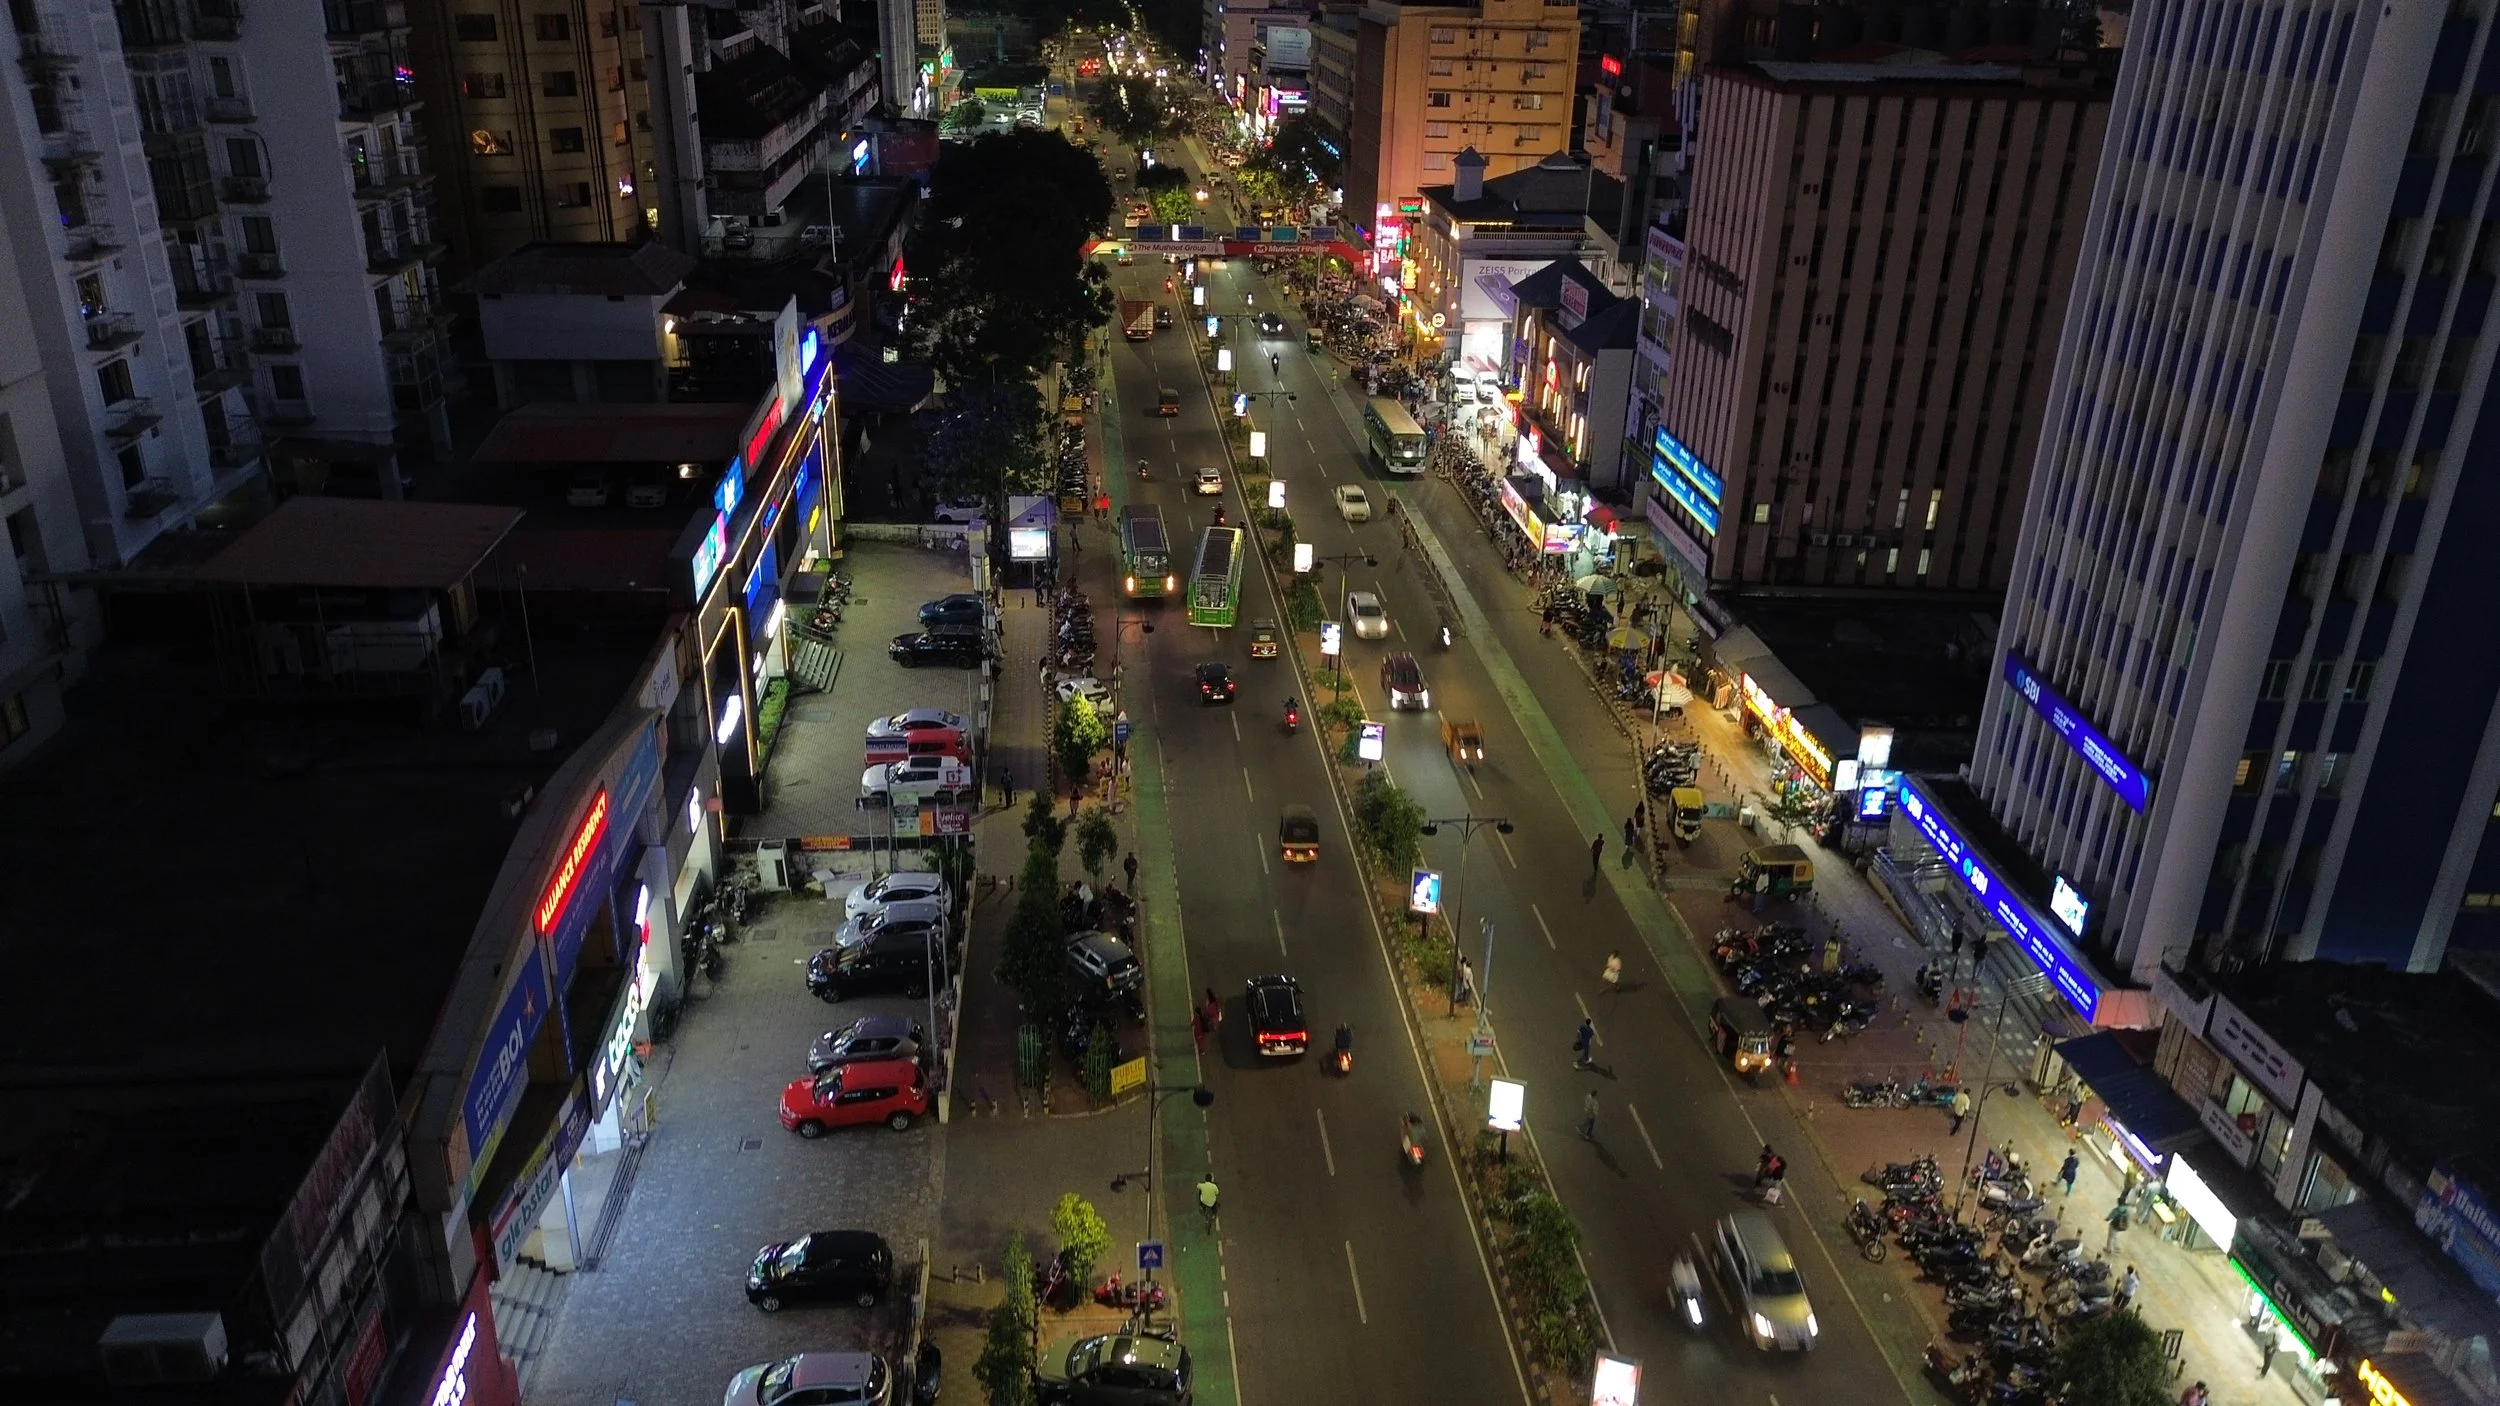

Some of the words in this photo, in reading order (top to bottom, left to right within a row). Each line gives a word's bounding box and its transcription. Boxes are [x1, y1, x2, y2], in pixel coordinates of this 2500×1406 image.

[1138, 243, 1151, 251] The
[1152, 243, 1183, 252] Muthoot
[1185, 243, 1207, 254] Group
[1479, 265, 1506, 275] ZEISS
[2023, 676, 2040, 704] SBI
[541, 855, 575, 931] ALLIANCE
[573, 791, 606, 866] RESIDENCY
[1970, 866, 1989, 895] SBI
[499, 1018, 524, 1083] BOI
[1114, 1060, 1143, 1078] PUBLIC
